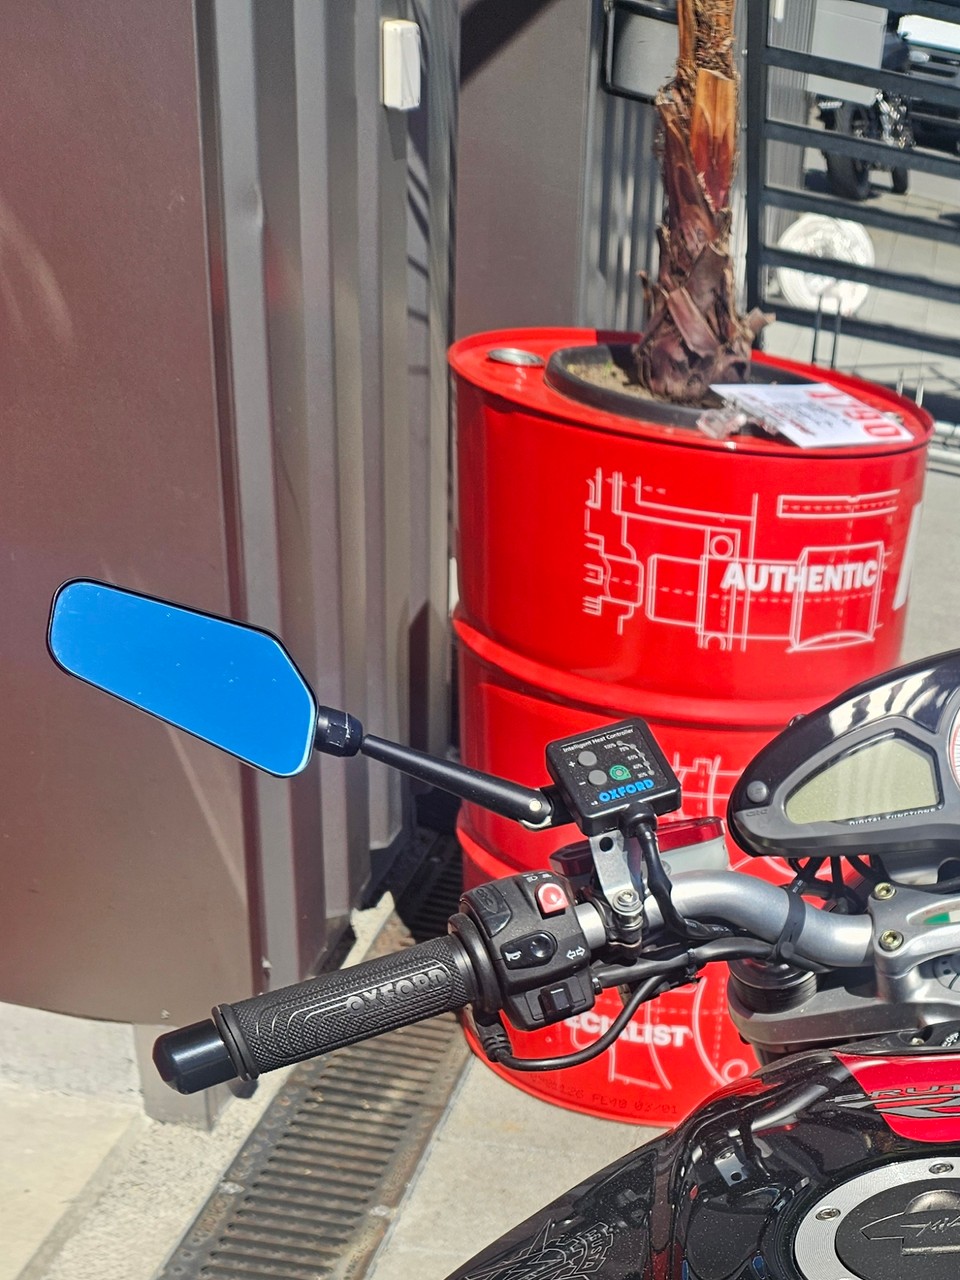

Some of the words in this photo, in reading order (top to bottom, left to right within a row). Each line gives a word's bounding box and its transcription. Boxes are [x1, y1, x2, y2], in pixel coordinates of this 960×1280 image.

[720, 560, 878, 593] AUTHENTIC
[563, 740, 592, 753] Intelligent
[592, 736, 606, 745] Heat
[606, 728, 634, 740] Controller
[599, 779, 654, 802] OXFORD
[346, 968, 448, 1016] OXFORD
[564, 1009, 684, 1047] ECILIST
